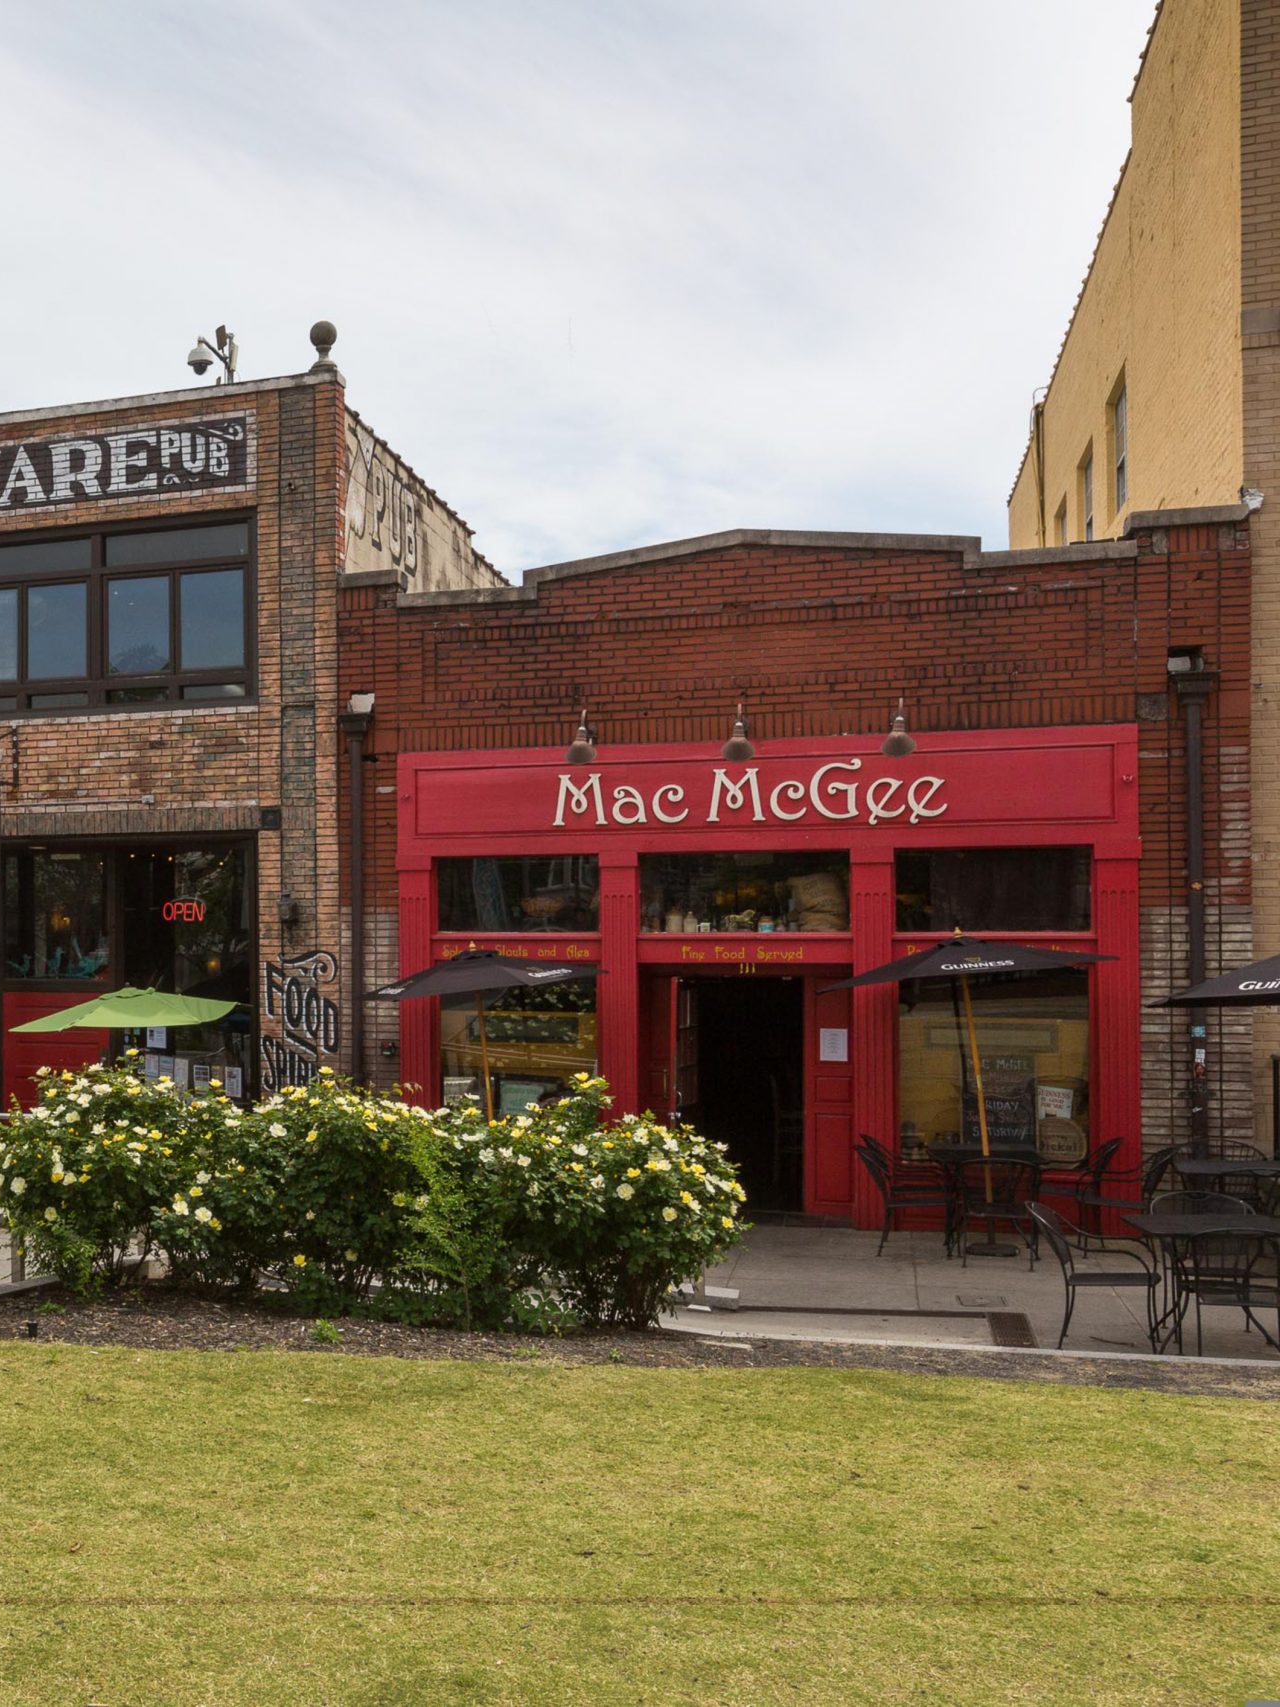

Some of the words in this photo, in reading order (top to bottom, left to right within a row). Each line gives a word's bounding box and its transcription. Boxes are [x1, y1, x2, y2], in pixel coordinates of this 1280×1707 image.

[161, 428, 231, 477] PUB
[371, 453, 418, 578] PUB
[552, 773, 689, 827] Mac
[706, 758, 948, 826] McGee
[162, 901, 204, 922] OPEN
[537, 945, 557, 957] and
[681, 945, 705, 961] Fine
[714, 946, 745, 960] Food
[756, 945, 804, 961] Served
[941, 959, 1015, 971] GUINNESS
[264, 960, 339, 1055] FOOD
[972, 1126, 1026, 1141] STURDAY
